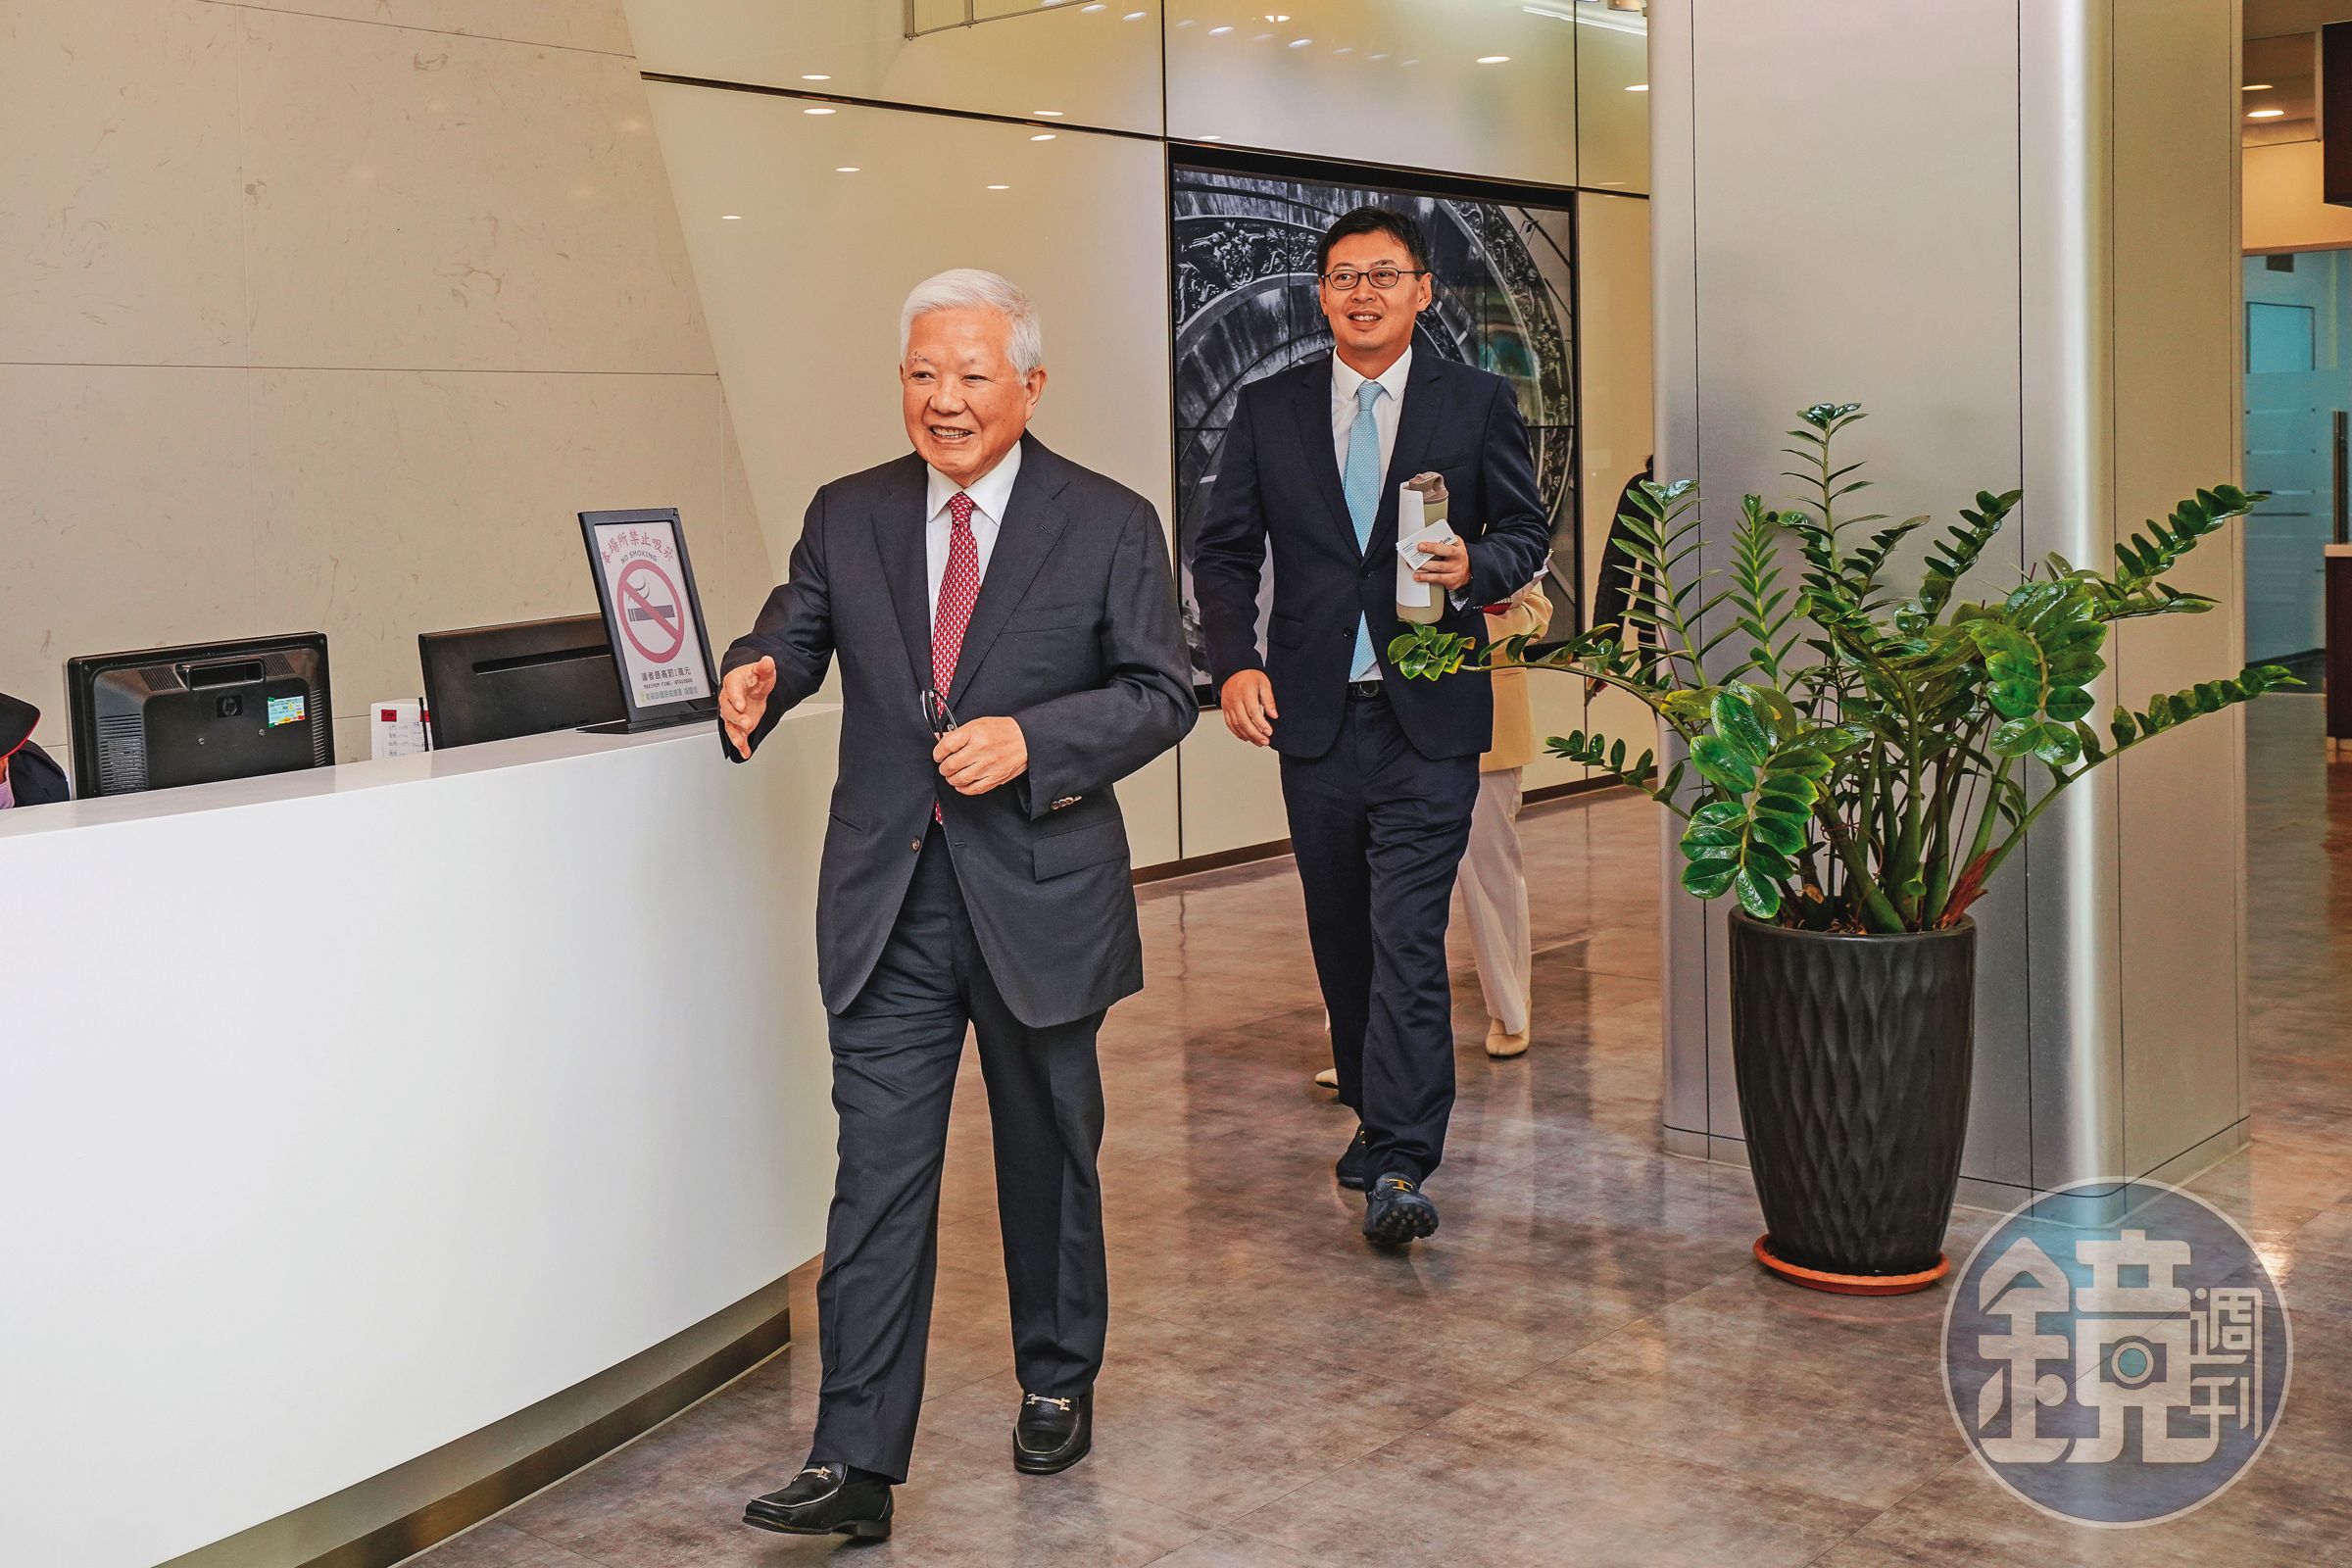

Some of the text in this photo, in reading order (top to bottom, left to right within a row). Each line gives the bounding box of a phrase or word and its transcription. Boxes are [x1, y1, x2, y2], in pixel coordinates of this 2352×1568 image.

[601, 528, 674, 564] 本場所禁止吸菸
[620, 550, 658, 564] NO SMOKING
